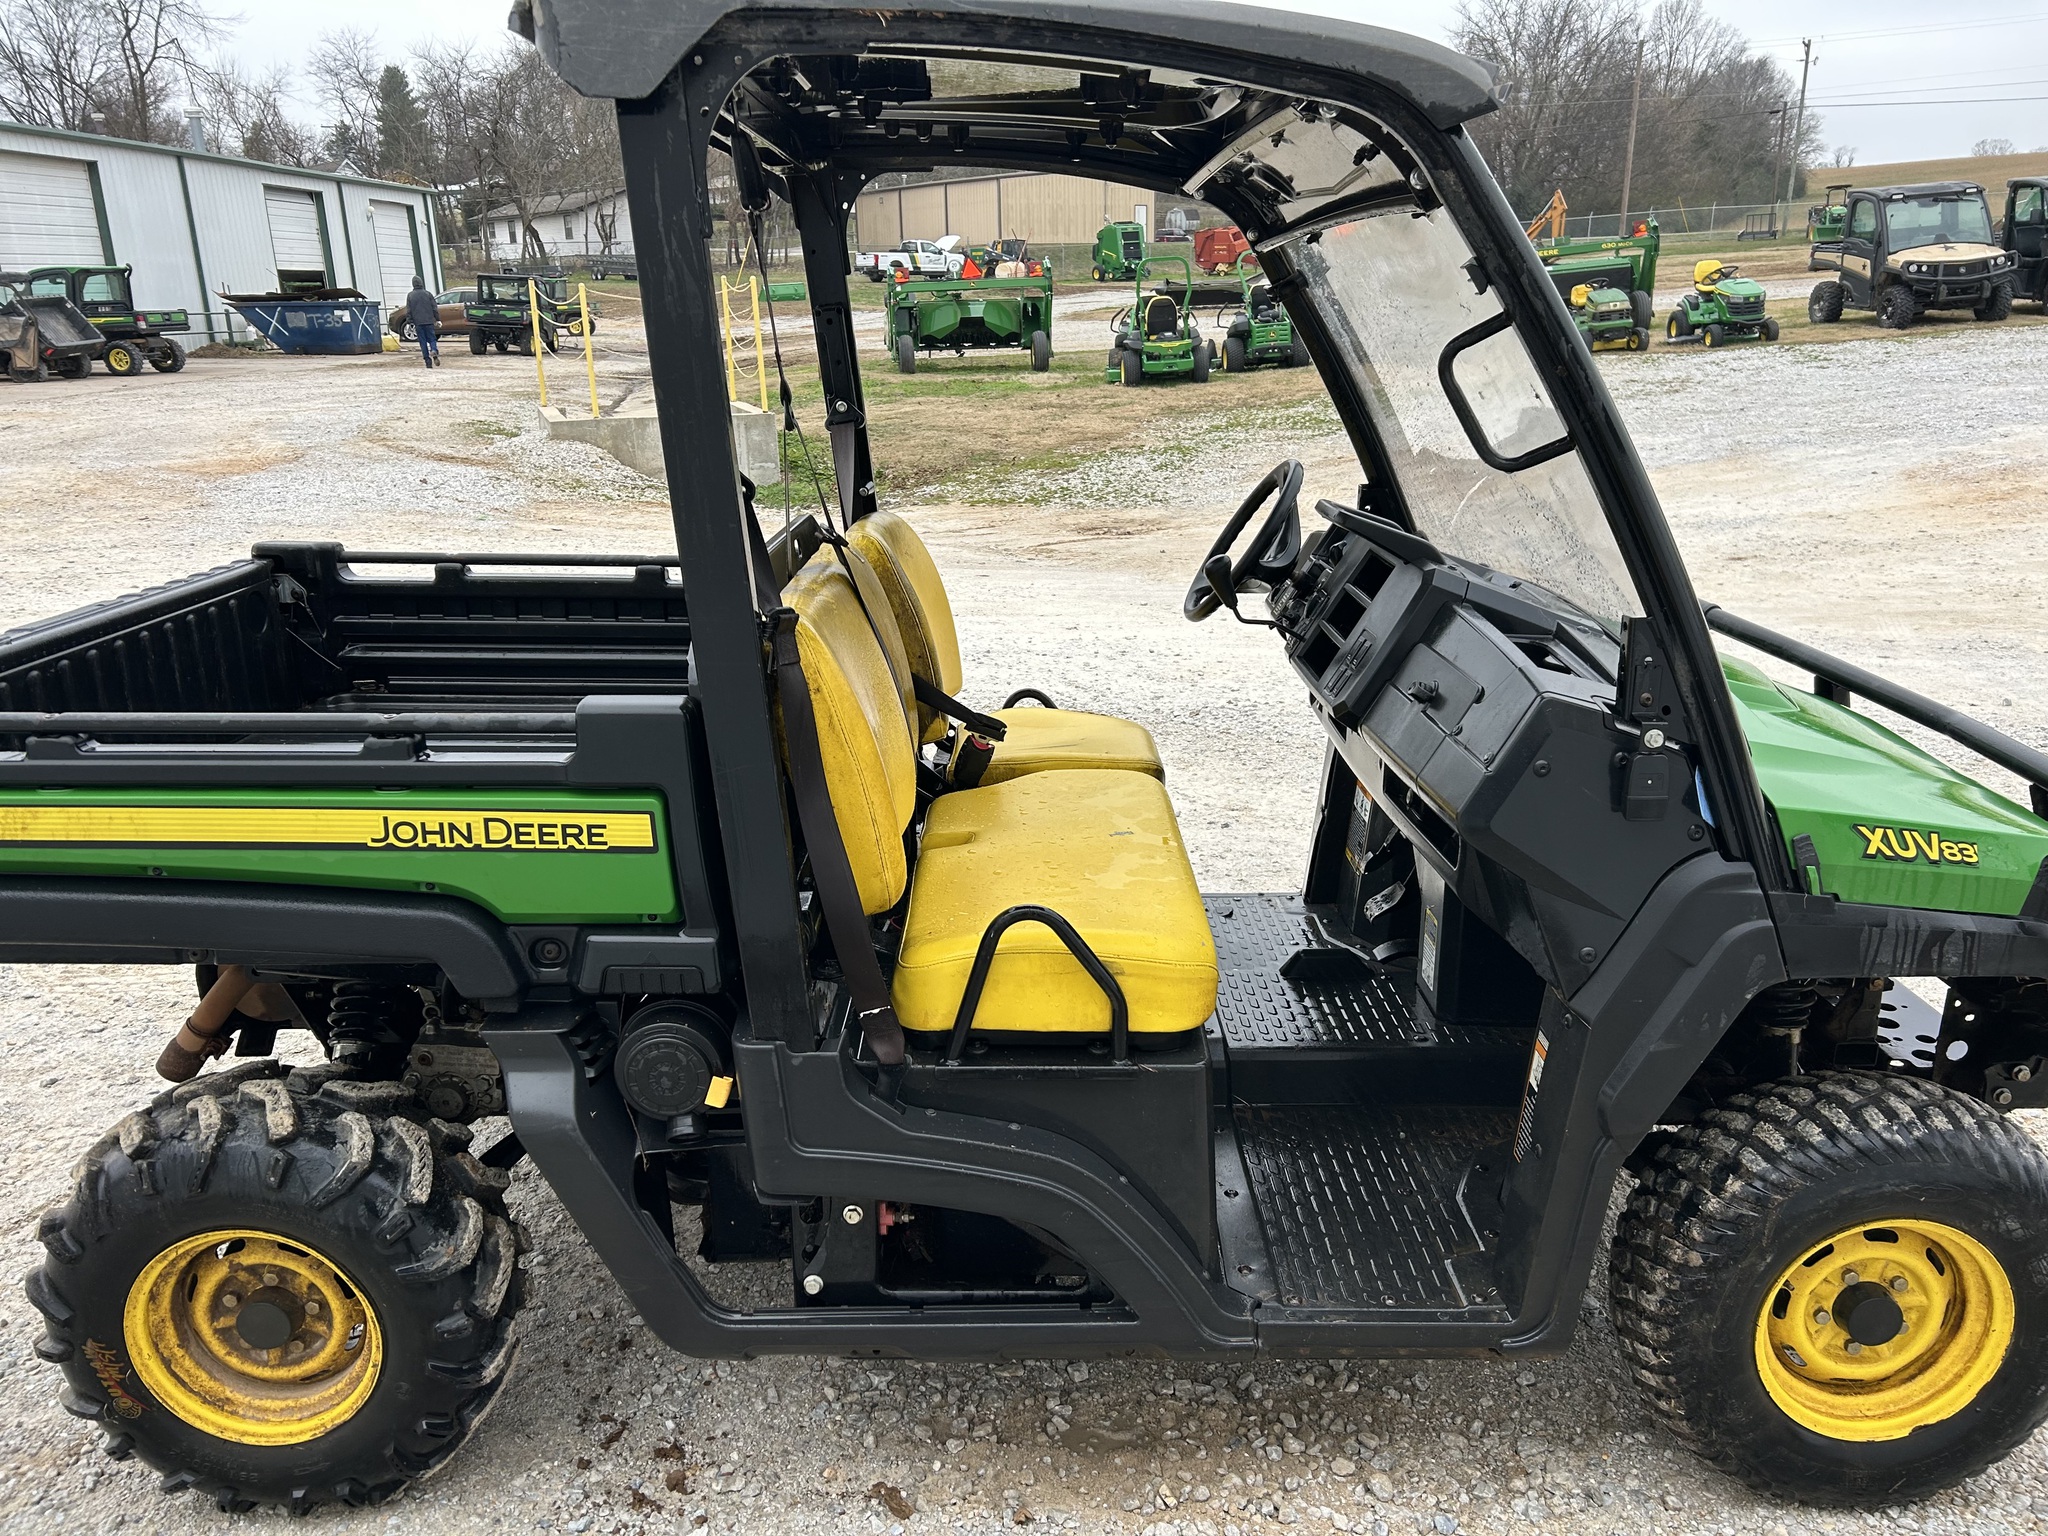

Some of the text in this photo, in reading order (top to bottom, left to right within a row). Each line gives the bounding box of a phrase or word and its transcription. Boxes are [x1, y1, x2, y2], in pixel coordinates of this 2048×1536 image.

[307, 312, 343, 329] T-35
[370, 816, 609, 846] JOHN DEERE
